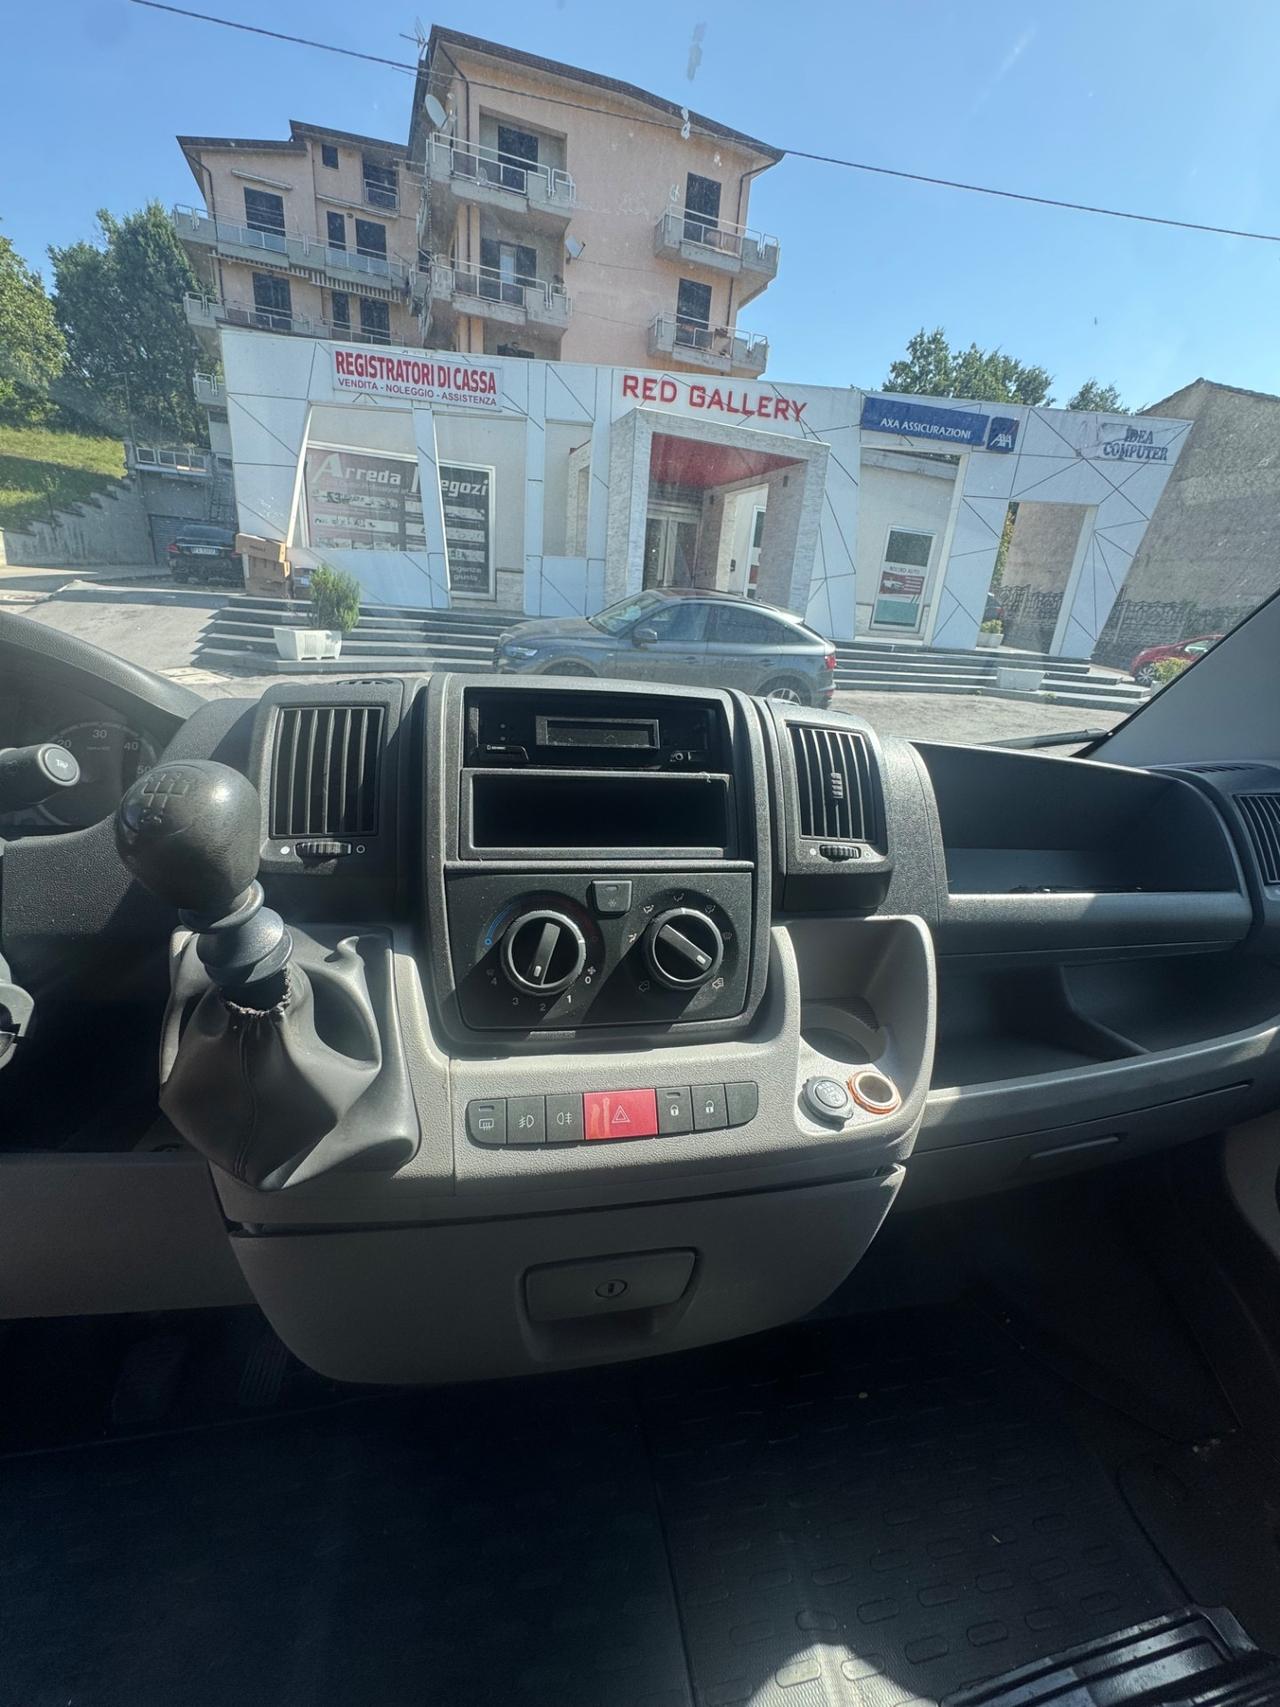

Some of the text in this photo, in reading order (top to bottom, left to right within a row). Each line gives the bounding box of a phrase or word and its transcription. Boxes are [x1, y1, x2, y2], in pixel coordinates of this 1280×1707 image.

[335, 350, 497, 395] REGISTRATORI DI CASSA
[338, 378, 378, 391] VENDITA
[386, 384, 434, 399] NOLEGGIO
[441, 391, 497, 406] ASSISTENZA
[622, 374, 808, 423] RED GALLERY
[880, 417, 972, 440] AXA ASSICURAZIONI
[1124, 427, 1153, 445] IDEA
[990, 433, 1013, 449] AXA
[1103, 441, 1168, 461] COMPUTER
[310, 452, 402, 486] Arreda
[92, 729, 107, 739] 30
[123, 741, 138, 751] 40
[566, 995, 572, 1004] 1
